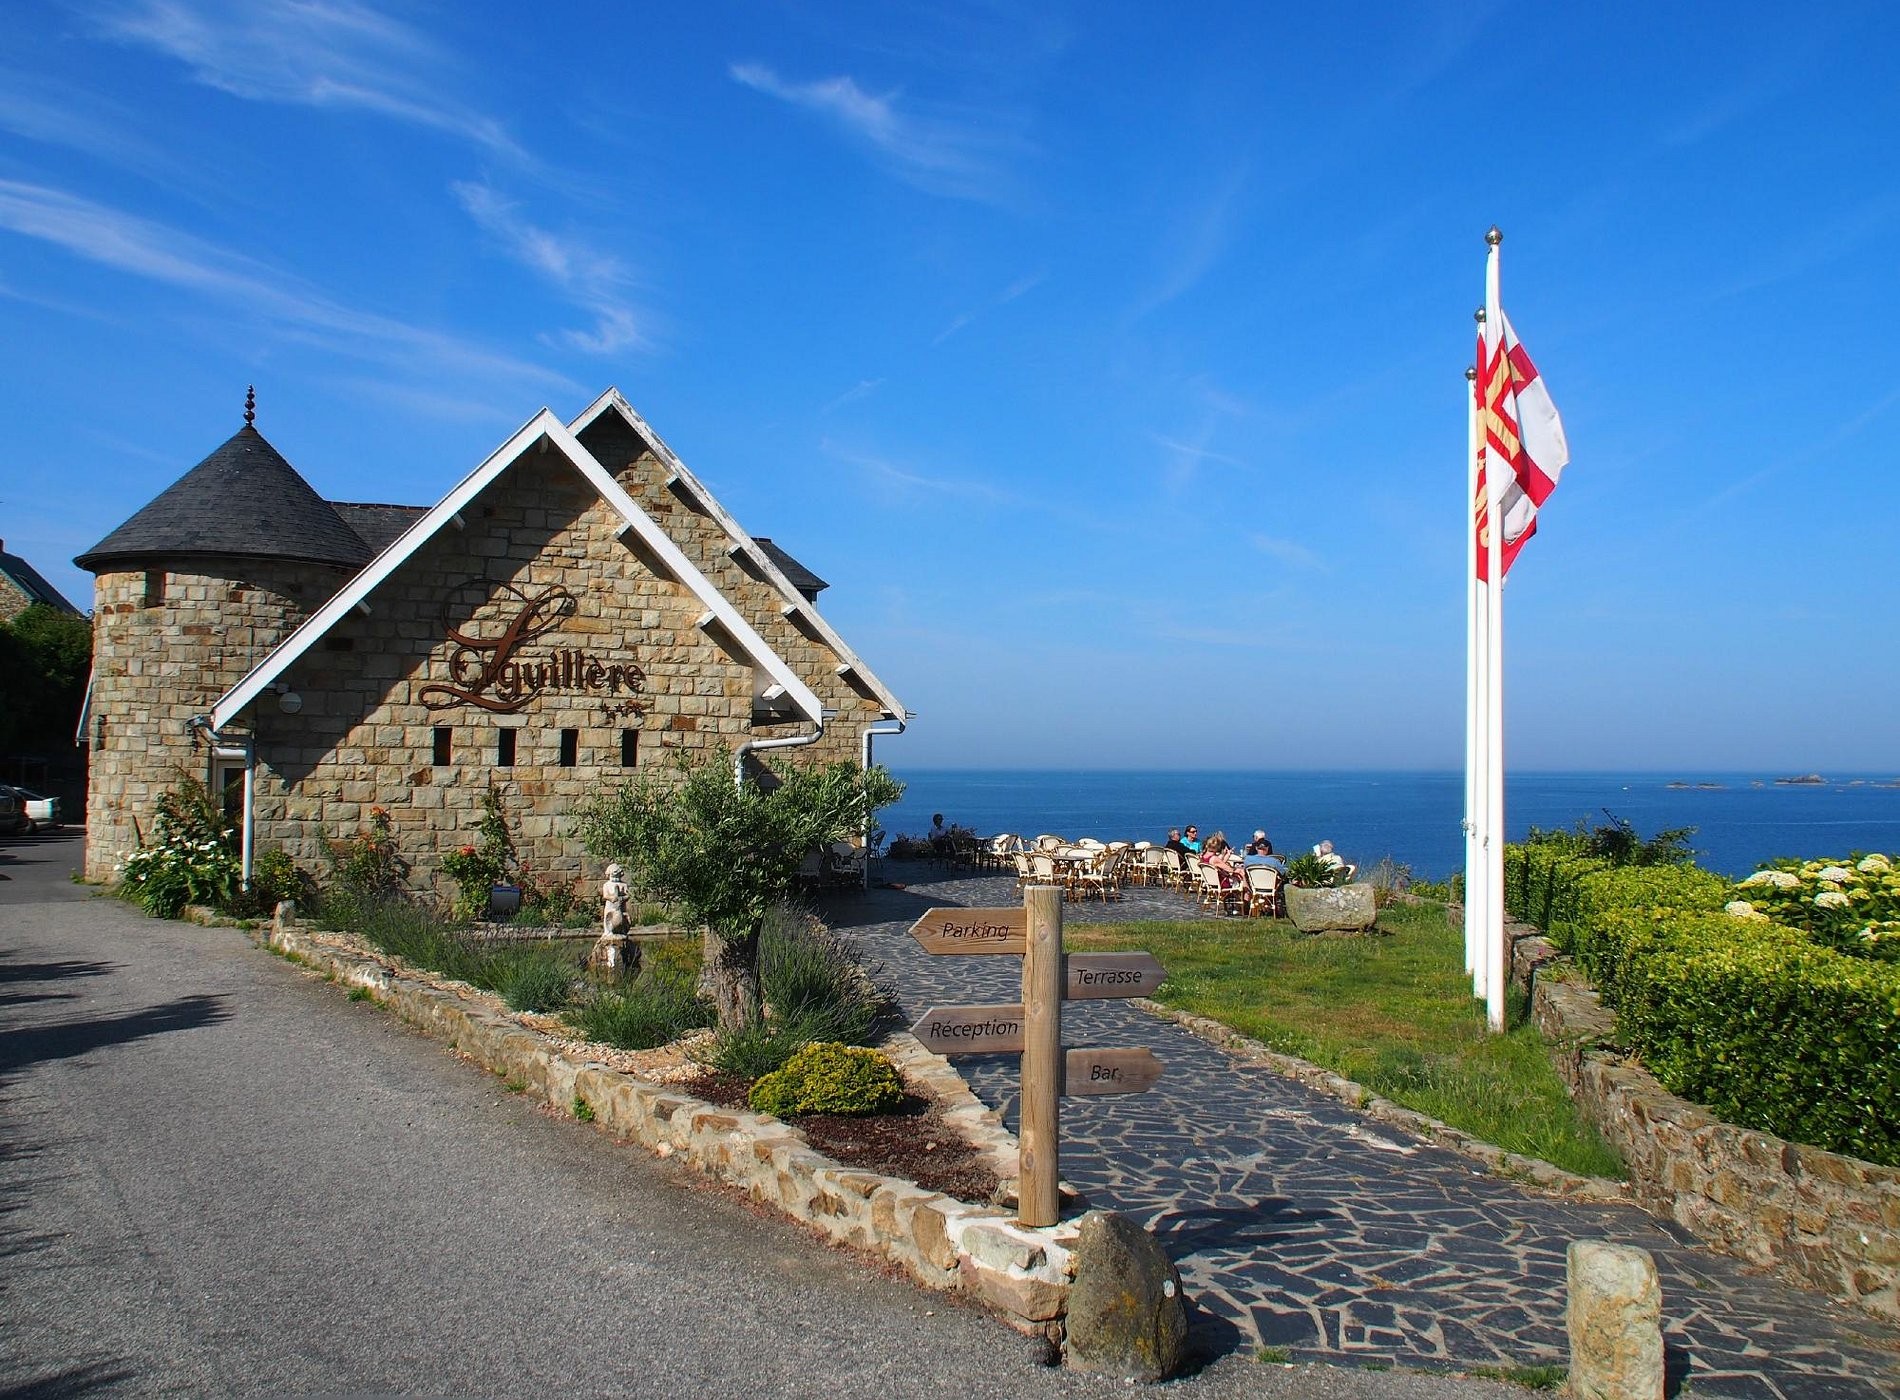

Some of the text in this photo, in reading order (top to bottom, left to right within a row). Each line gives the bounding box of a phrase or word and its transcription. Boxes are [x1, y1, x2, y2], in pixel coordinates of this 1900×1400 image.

[942, 921, 1009, 941] Parking
[1076, 969, 1142, 985] Terrasse
[930, 1019, 1018, 1040] Réception
[1091, 1065, 1119, 1080] Bar
